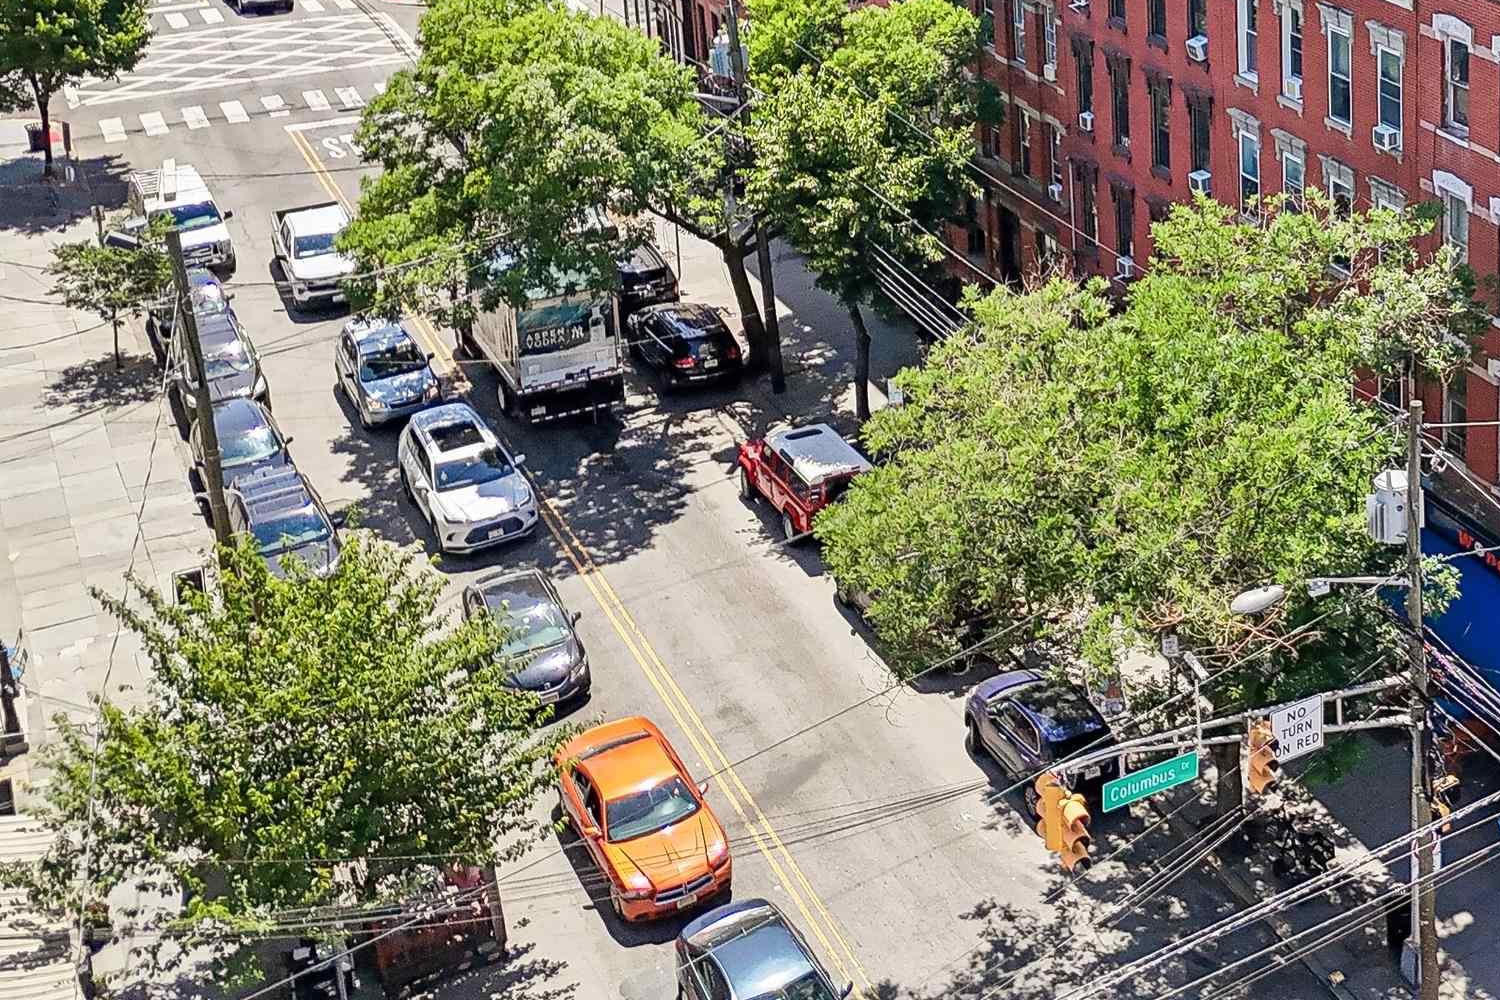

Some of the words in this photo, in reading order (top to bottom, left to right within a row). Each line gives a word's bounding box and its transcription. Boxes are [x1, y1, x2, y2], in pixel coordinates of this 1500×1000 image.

[1287, 706, 1306, 723] NO
[1281, 718, 1313, 740] TURN
[1275, 743, 1290, 758] ON
[1296, 732, 1320, 750] RED
[1110, 768, 1176, 802] Columbus
